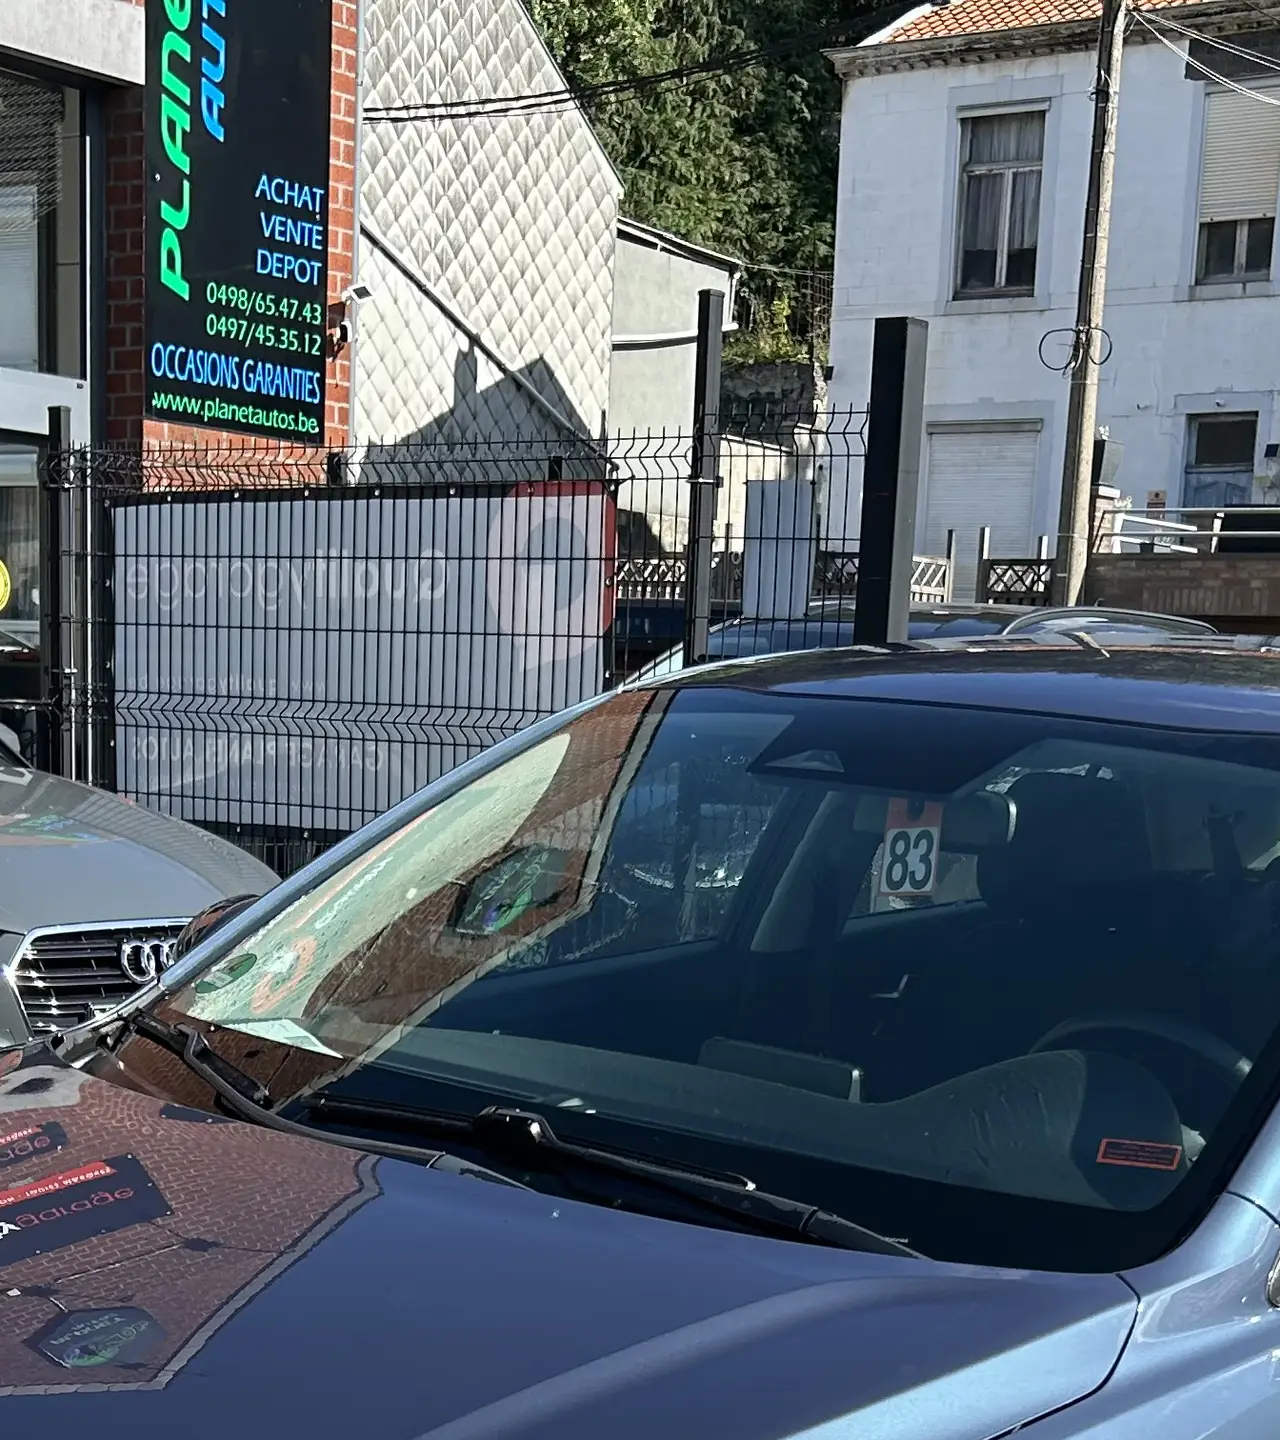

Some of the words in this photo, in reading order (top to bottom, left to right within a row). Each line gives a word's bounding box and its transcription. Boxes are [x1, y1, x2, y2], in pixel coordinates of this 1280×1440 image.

[254, 174, 325, 214] ACHAT
[260, 210, 324, 251] VENTE
[256, 248, 323, 287] DEPOT
[206, 281, 323, 326] 0498/65.47.43
[206, 313, 322, 356] 0497/45.35.12
[151, 342, 240, 391] OCCASIONS
[242, 359, 321, 405] GARANTIES
[154, 391, 319, 434] www.planetautos.be
[885, 829, 935, 891] 83
